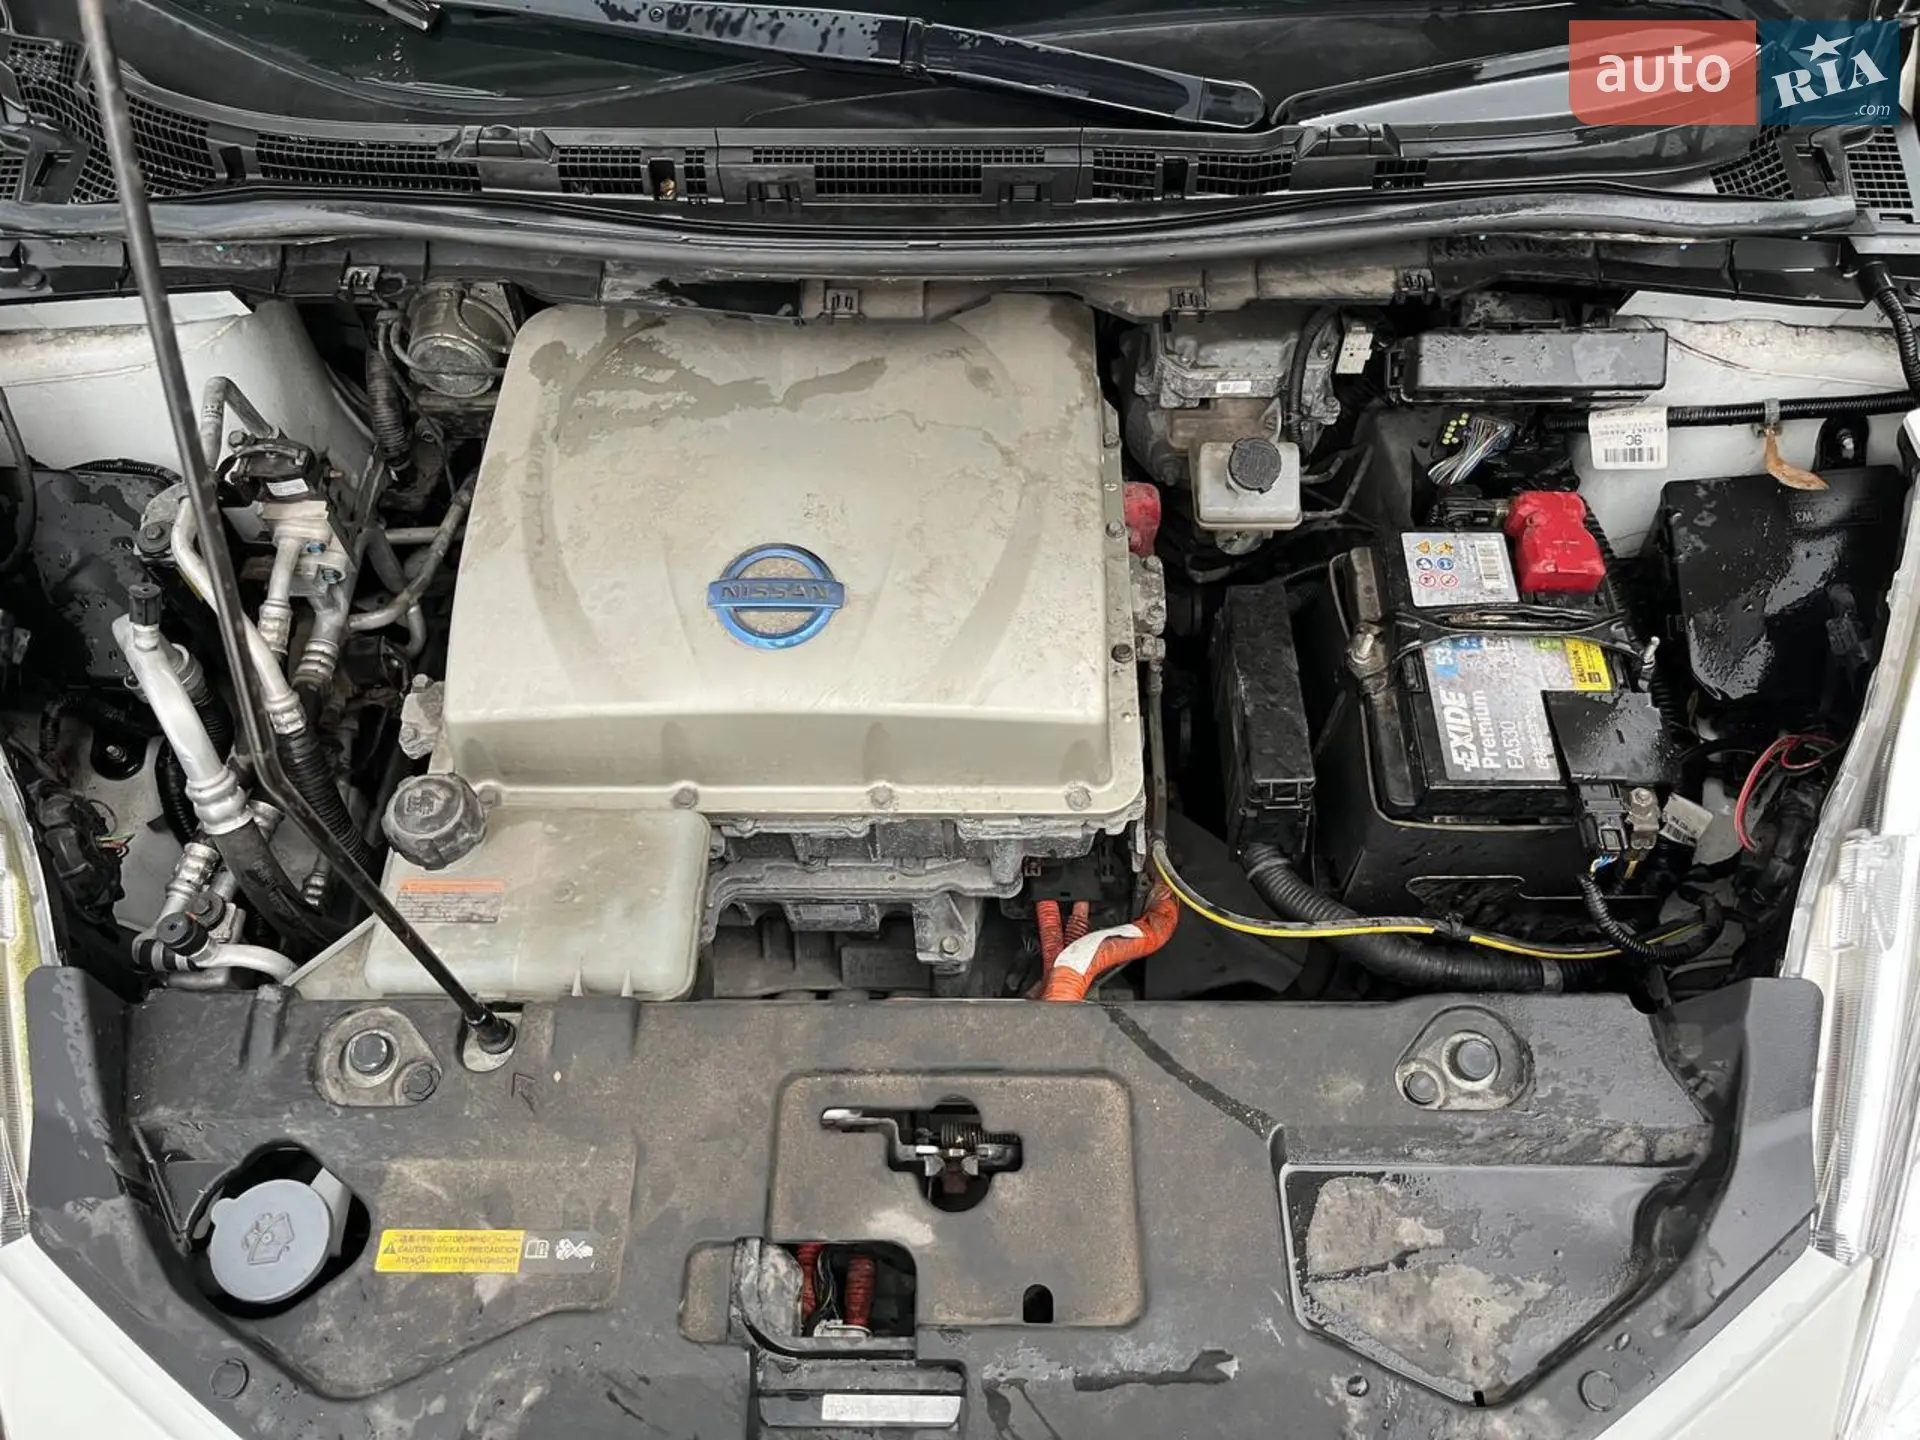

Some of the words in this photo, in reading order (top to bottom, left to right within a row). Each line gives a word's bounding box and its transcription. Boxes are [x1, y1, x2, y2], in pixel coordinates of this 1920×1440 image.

[721, 583, 830, 600] NISSAN
[1573, 650, 1587, 683] CAUTION
[1439, 687, 1480, 773] EXIDE
[1471, 689, 1502, 769] Premium
[1501, 720, 1524, 769] EA530
